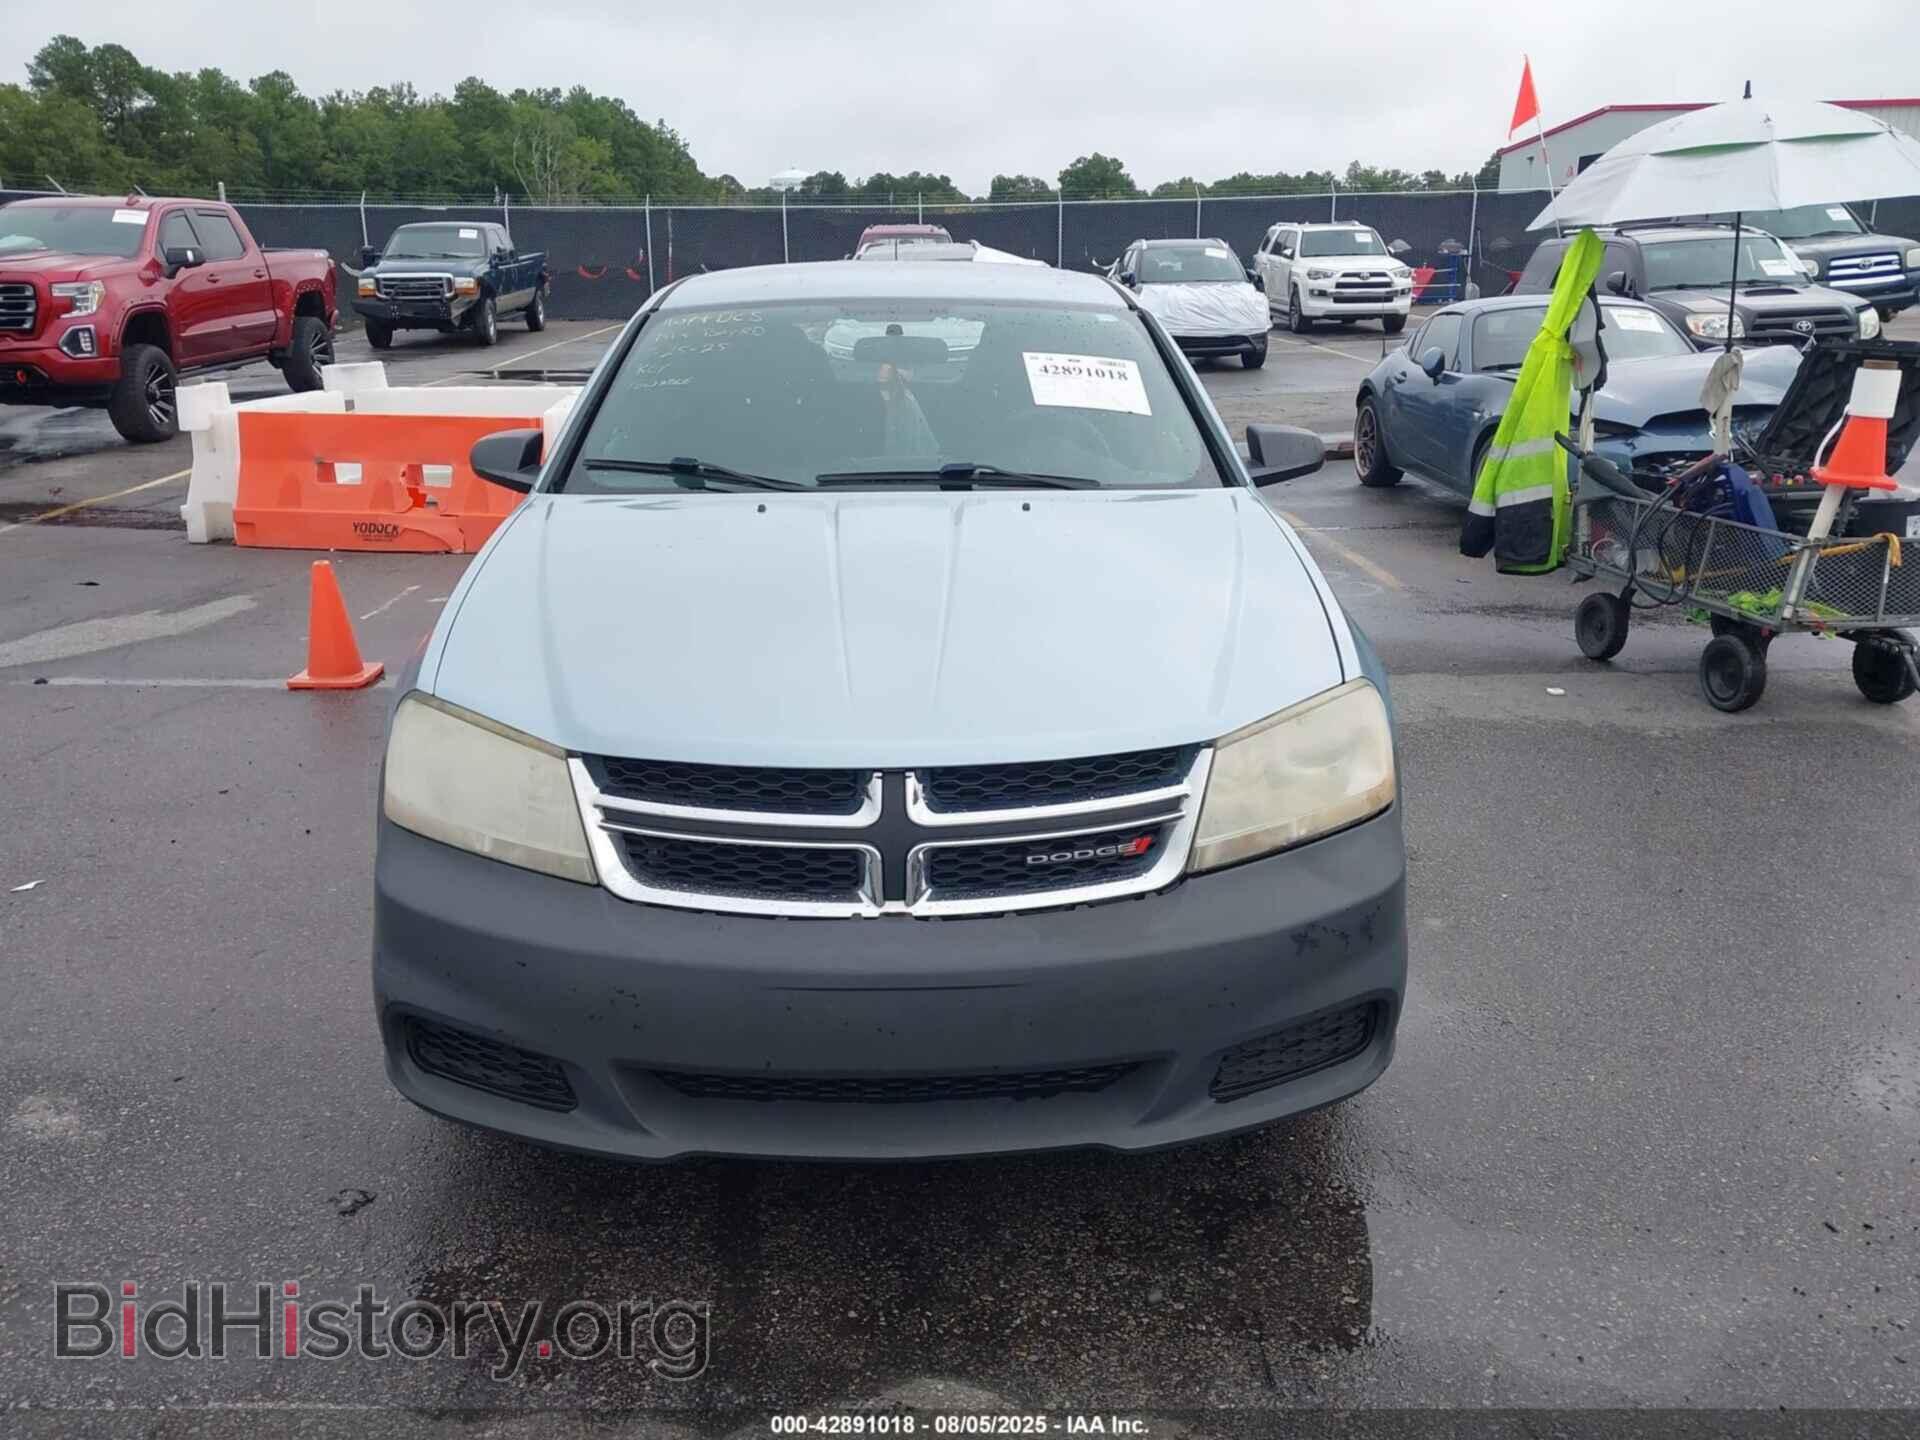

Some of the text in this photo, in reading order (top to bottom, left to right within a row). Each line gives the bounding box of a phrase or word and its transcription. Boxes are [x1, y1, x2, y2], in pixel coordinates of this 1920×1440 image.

[1039, 364, 1128, 381] 42891018
[352, 521, 400, 537] YODOCK
[1026, 841, 1138, 865] DODGE
